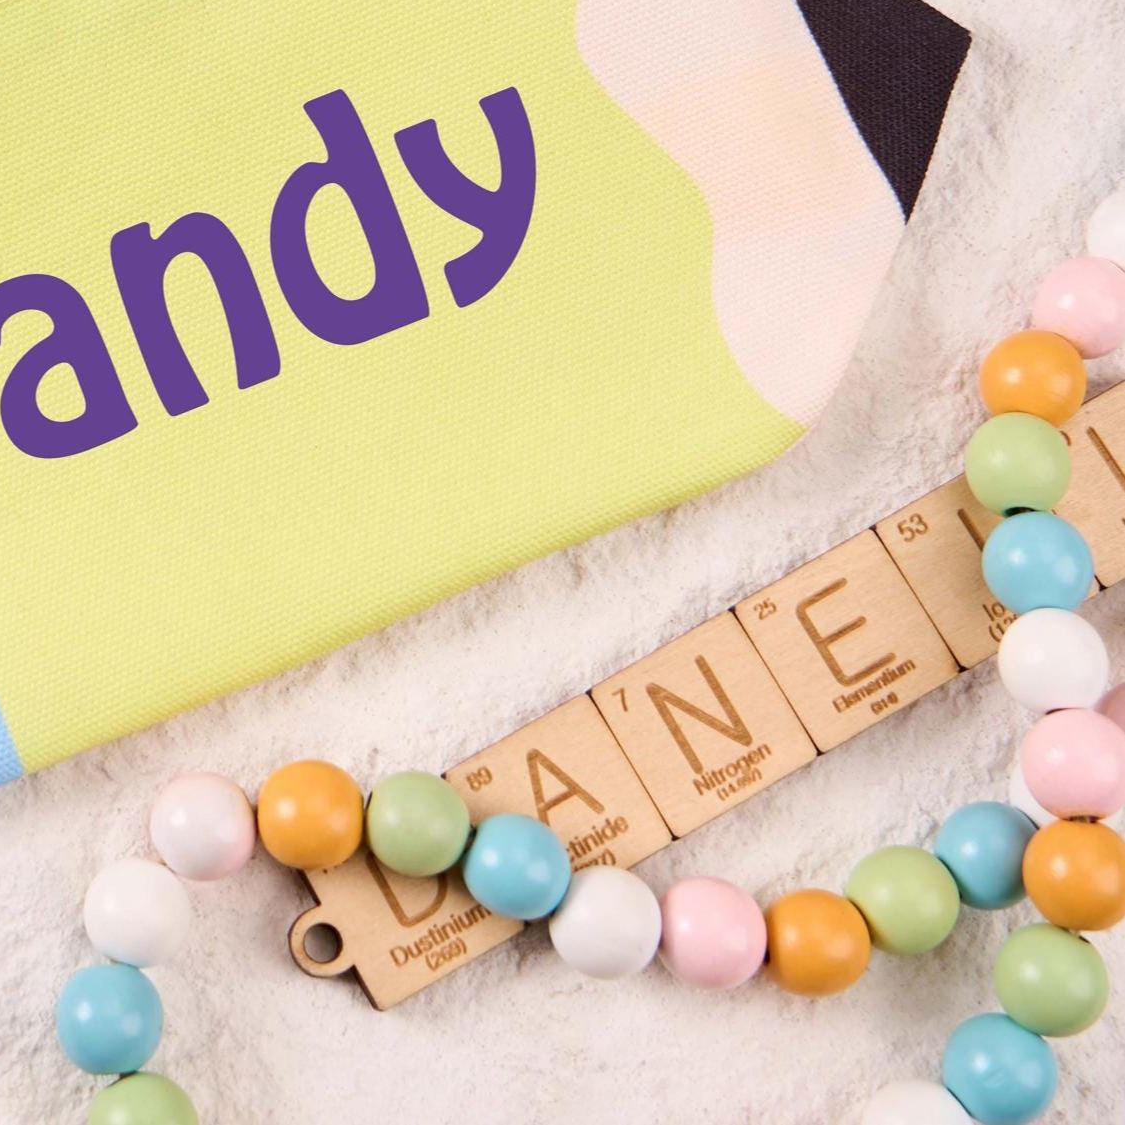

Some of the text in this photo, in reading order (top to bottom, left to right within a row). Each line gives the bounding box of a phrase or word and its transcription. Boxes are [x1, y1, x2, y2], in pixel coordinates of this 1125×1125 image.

[897, 512, 929, 543] 53
[753, 597, 777, 620] 25
[612, 687, 629, 713] 7
[832, 659, 917, 714] Elementium
[466, 766, 493, 792] 89
[692, 742, 773, 797] Nitrogen
[389, 903, 493, 968] Dustinium
